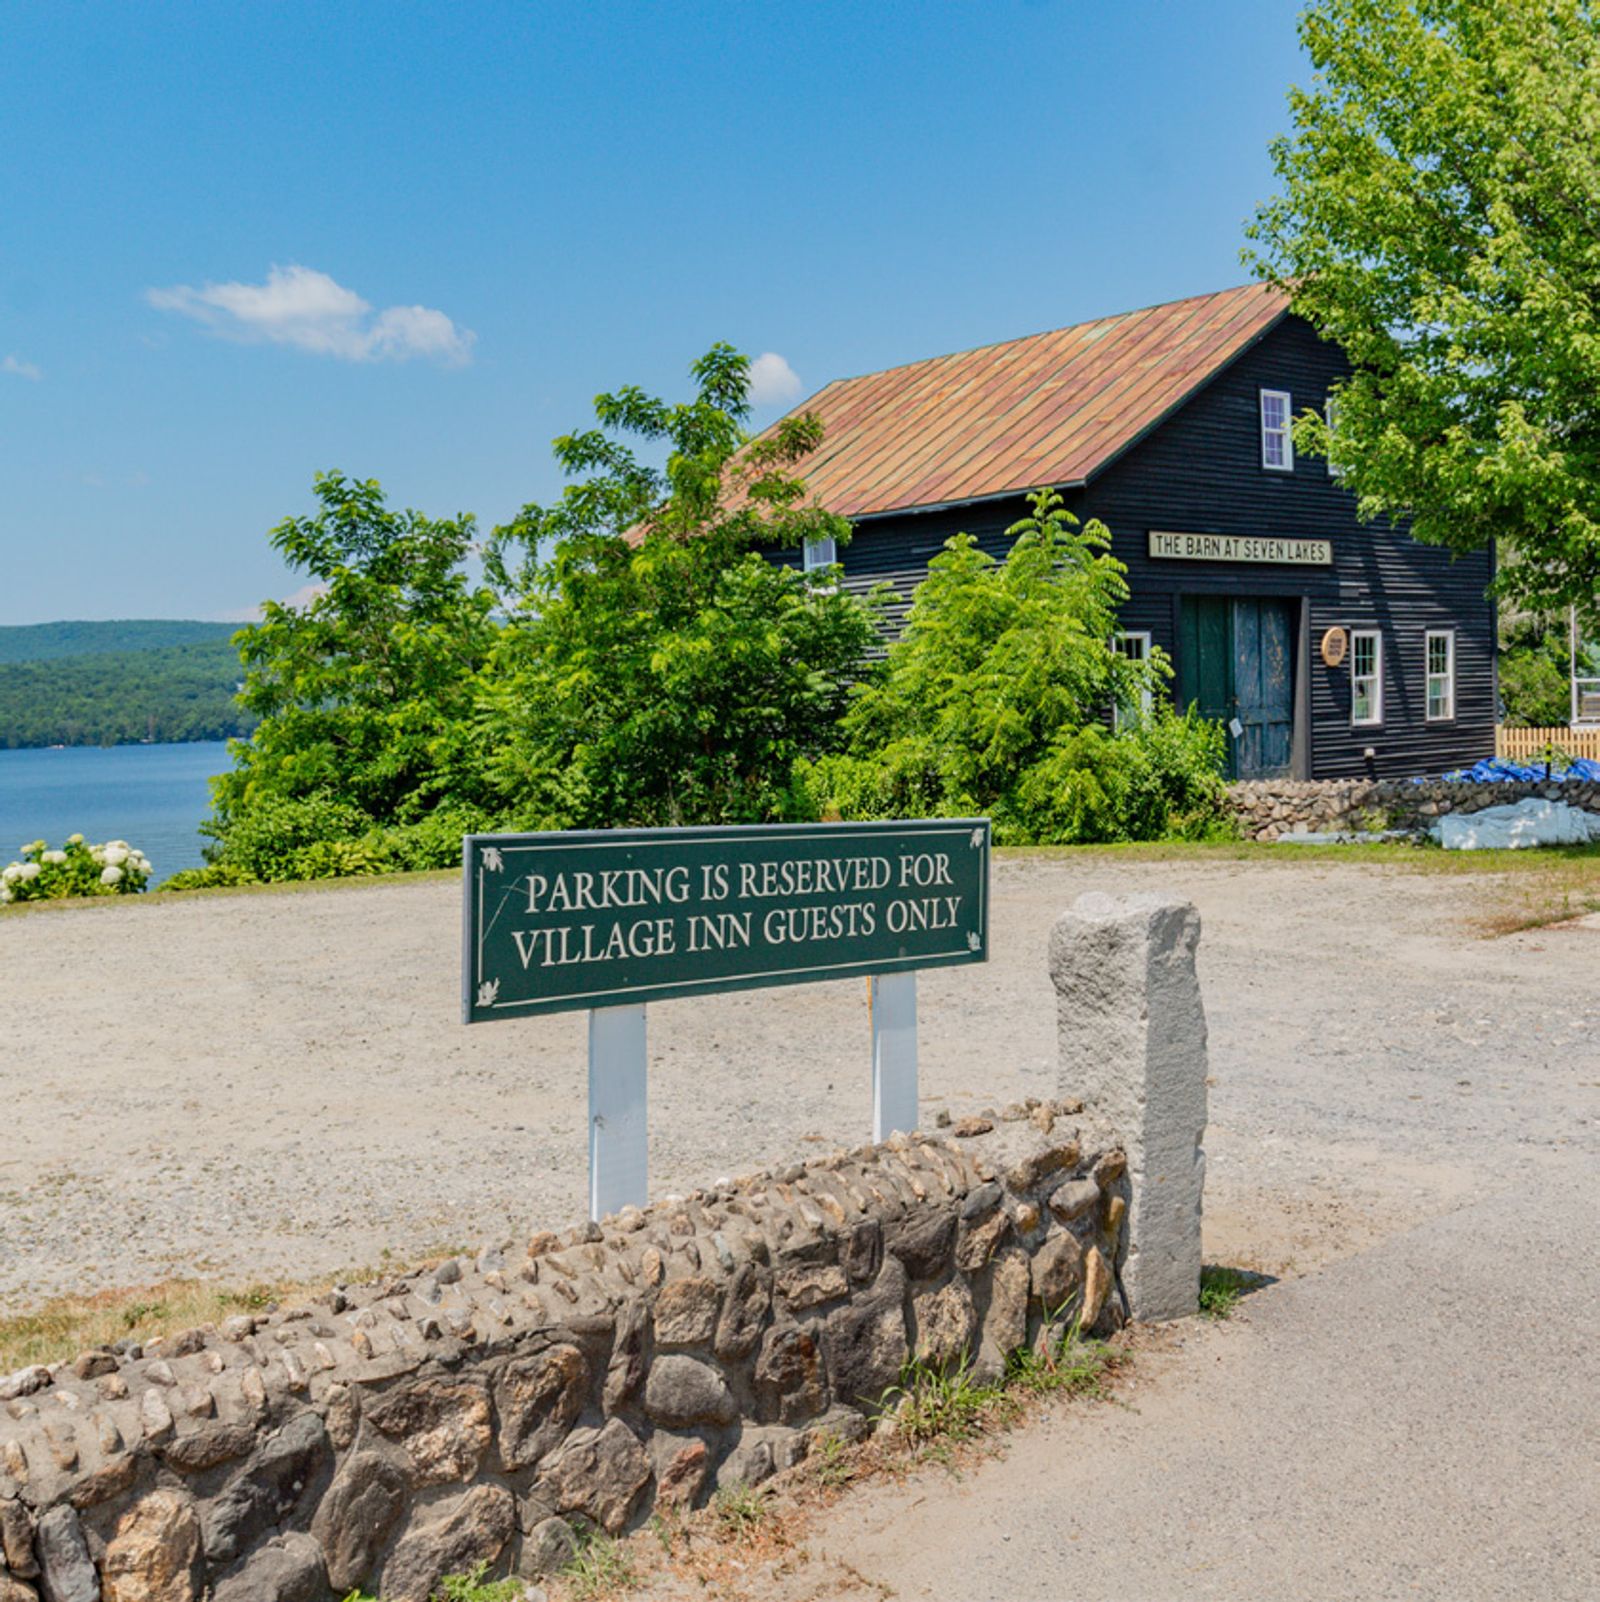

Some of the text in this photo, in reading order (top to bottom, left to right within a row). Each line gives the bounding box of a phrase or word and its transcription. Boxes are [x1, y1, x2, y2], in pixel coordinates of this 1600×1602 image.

[1155, 535, 1326, 561] THE BARN AT SEVEN LAKES
[524, 852, 954, 914] PARKING IS RESERVED FOR
[511, 895, 962, 970] VILLAGE INN GUESTS ONLY
